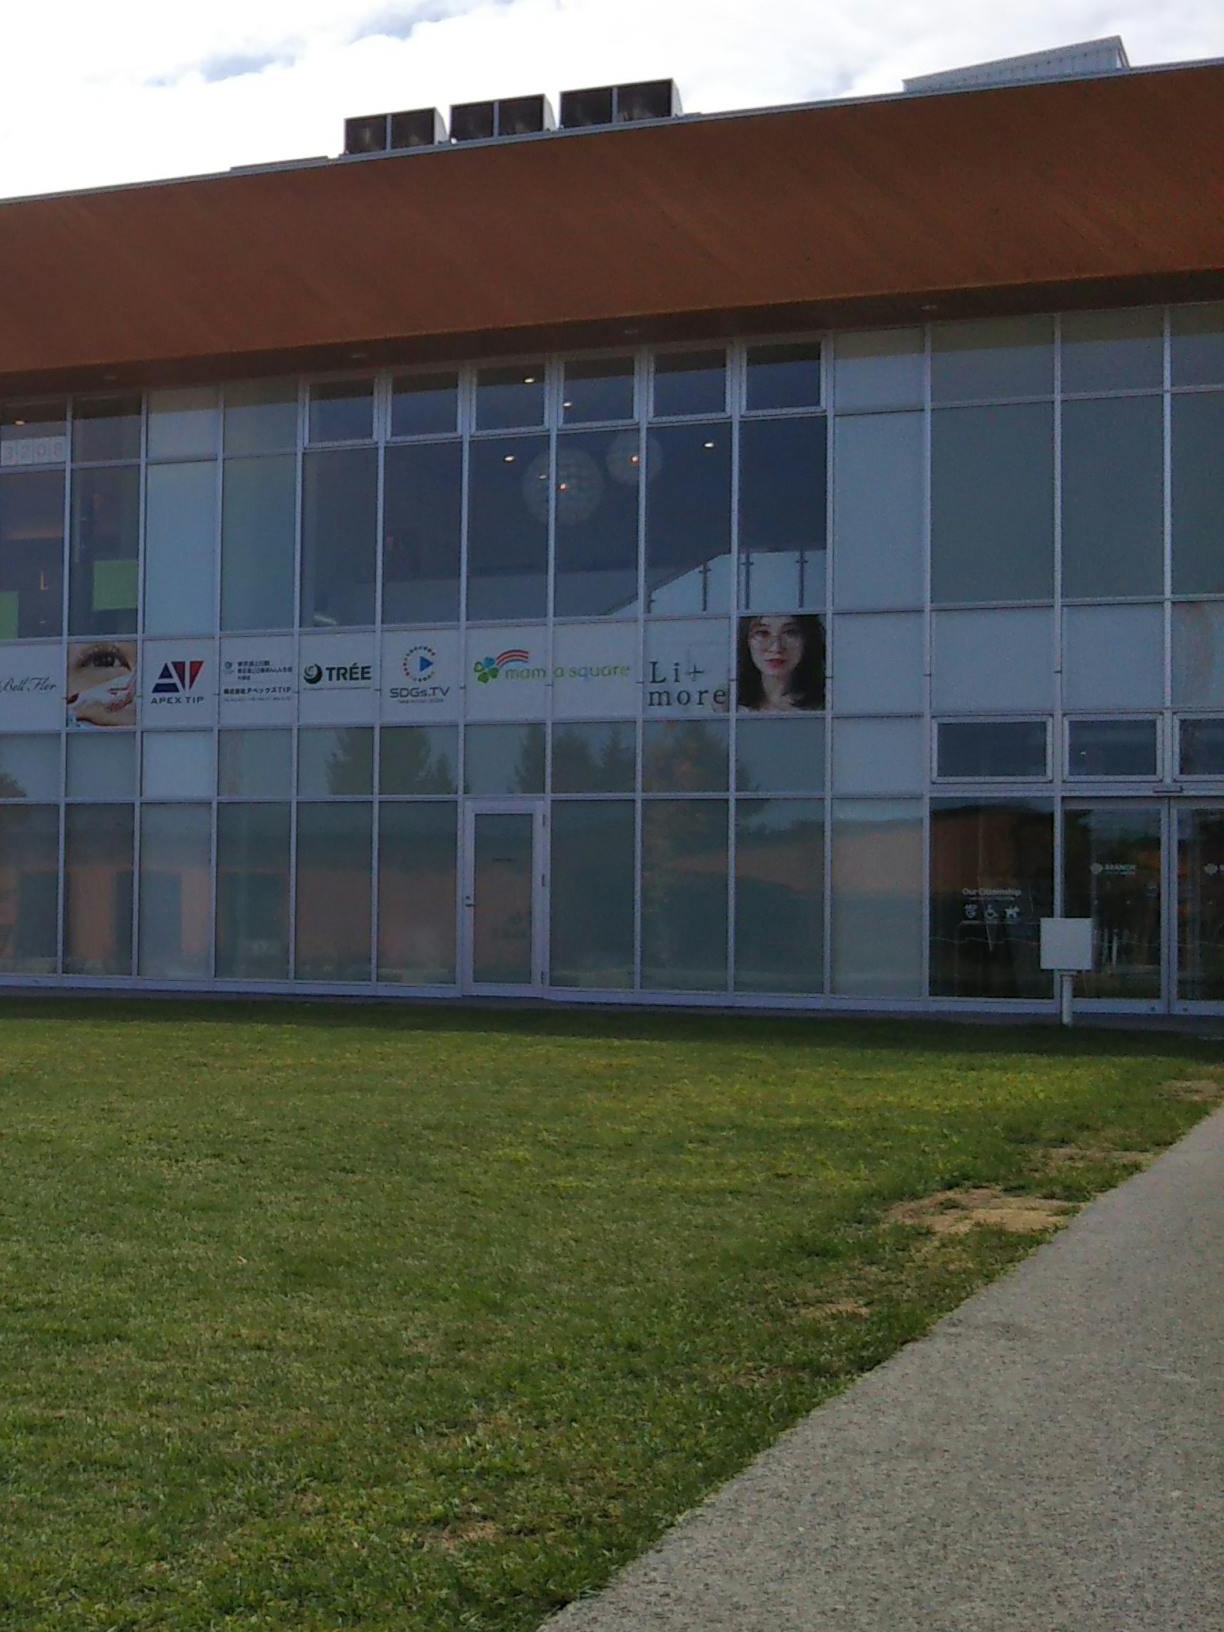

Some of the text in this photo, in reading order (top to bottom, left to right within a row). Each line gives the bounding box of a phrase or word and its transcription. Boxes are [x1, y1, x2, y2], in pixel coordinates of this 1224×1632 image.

[326, 662, 372, 682] TRÉE
[569, 665, 631, 682] square
[150, 695, 205, 705] APEX TIP
[390, 686, 450, 698] SDGs.TV
[648, 688, 727, 707] more
